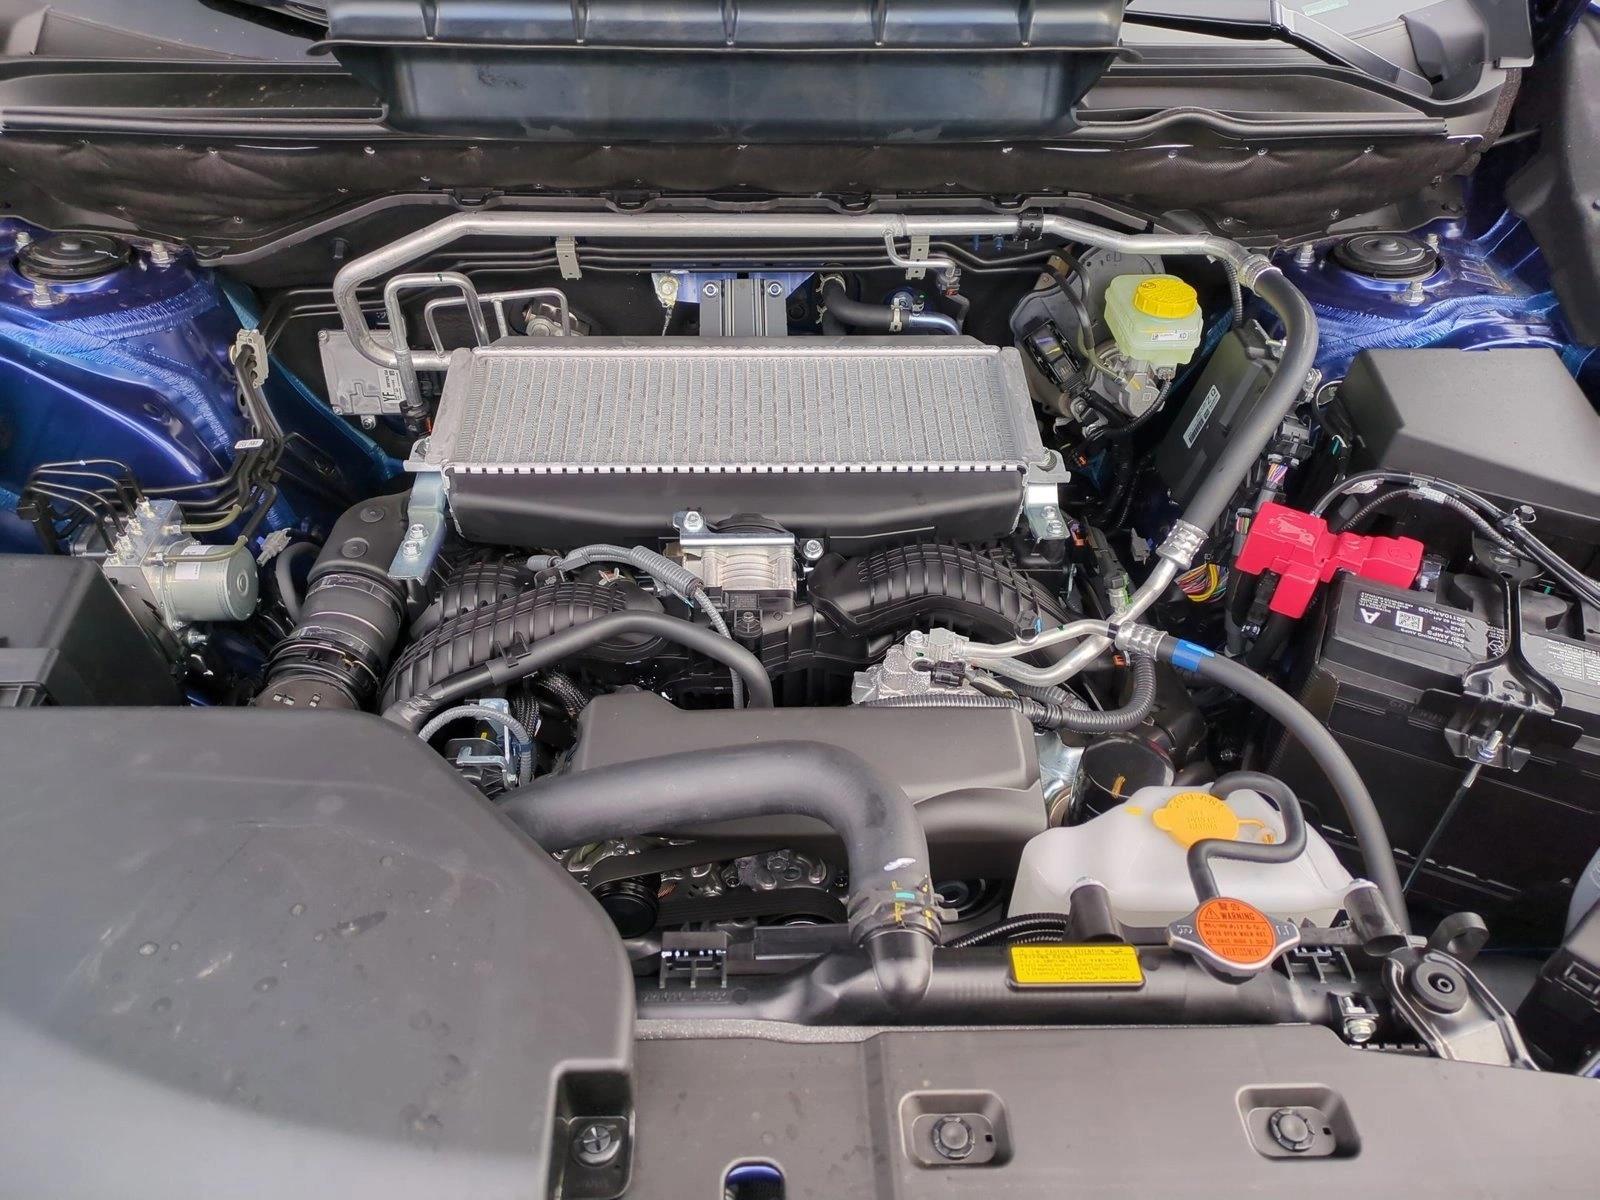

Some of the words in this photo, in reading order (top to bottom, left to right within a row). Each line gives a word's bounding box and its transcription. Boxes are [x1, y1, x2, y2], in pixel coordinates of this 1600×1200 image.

[1360, 608, 1380, 624] A
[1426, 629, 1449, 639] AMPS
[1221, 912, 1256, 921] WARNING
